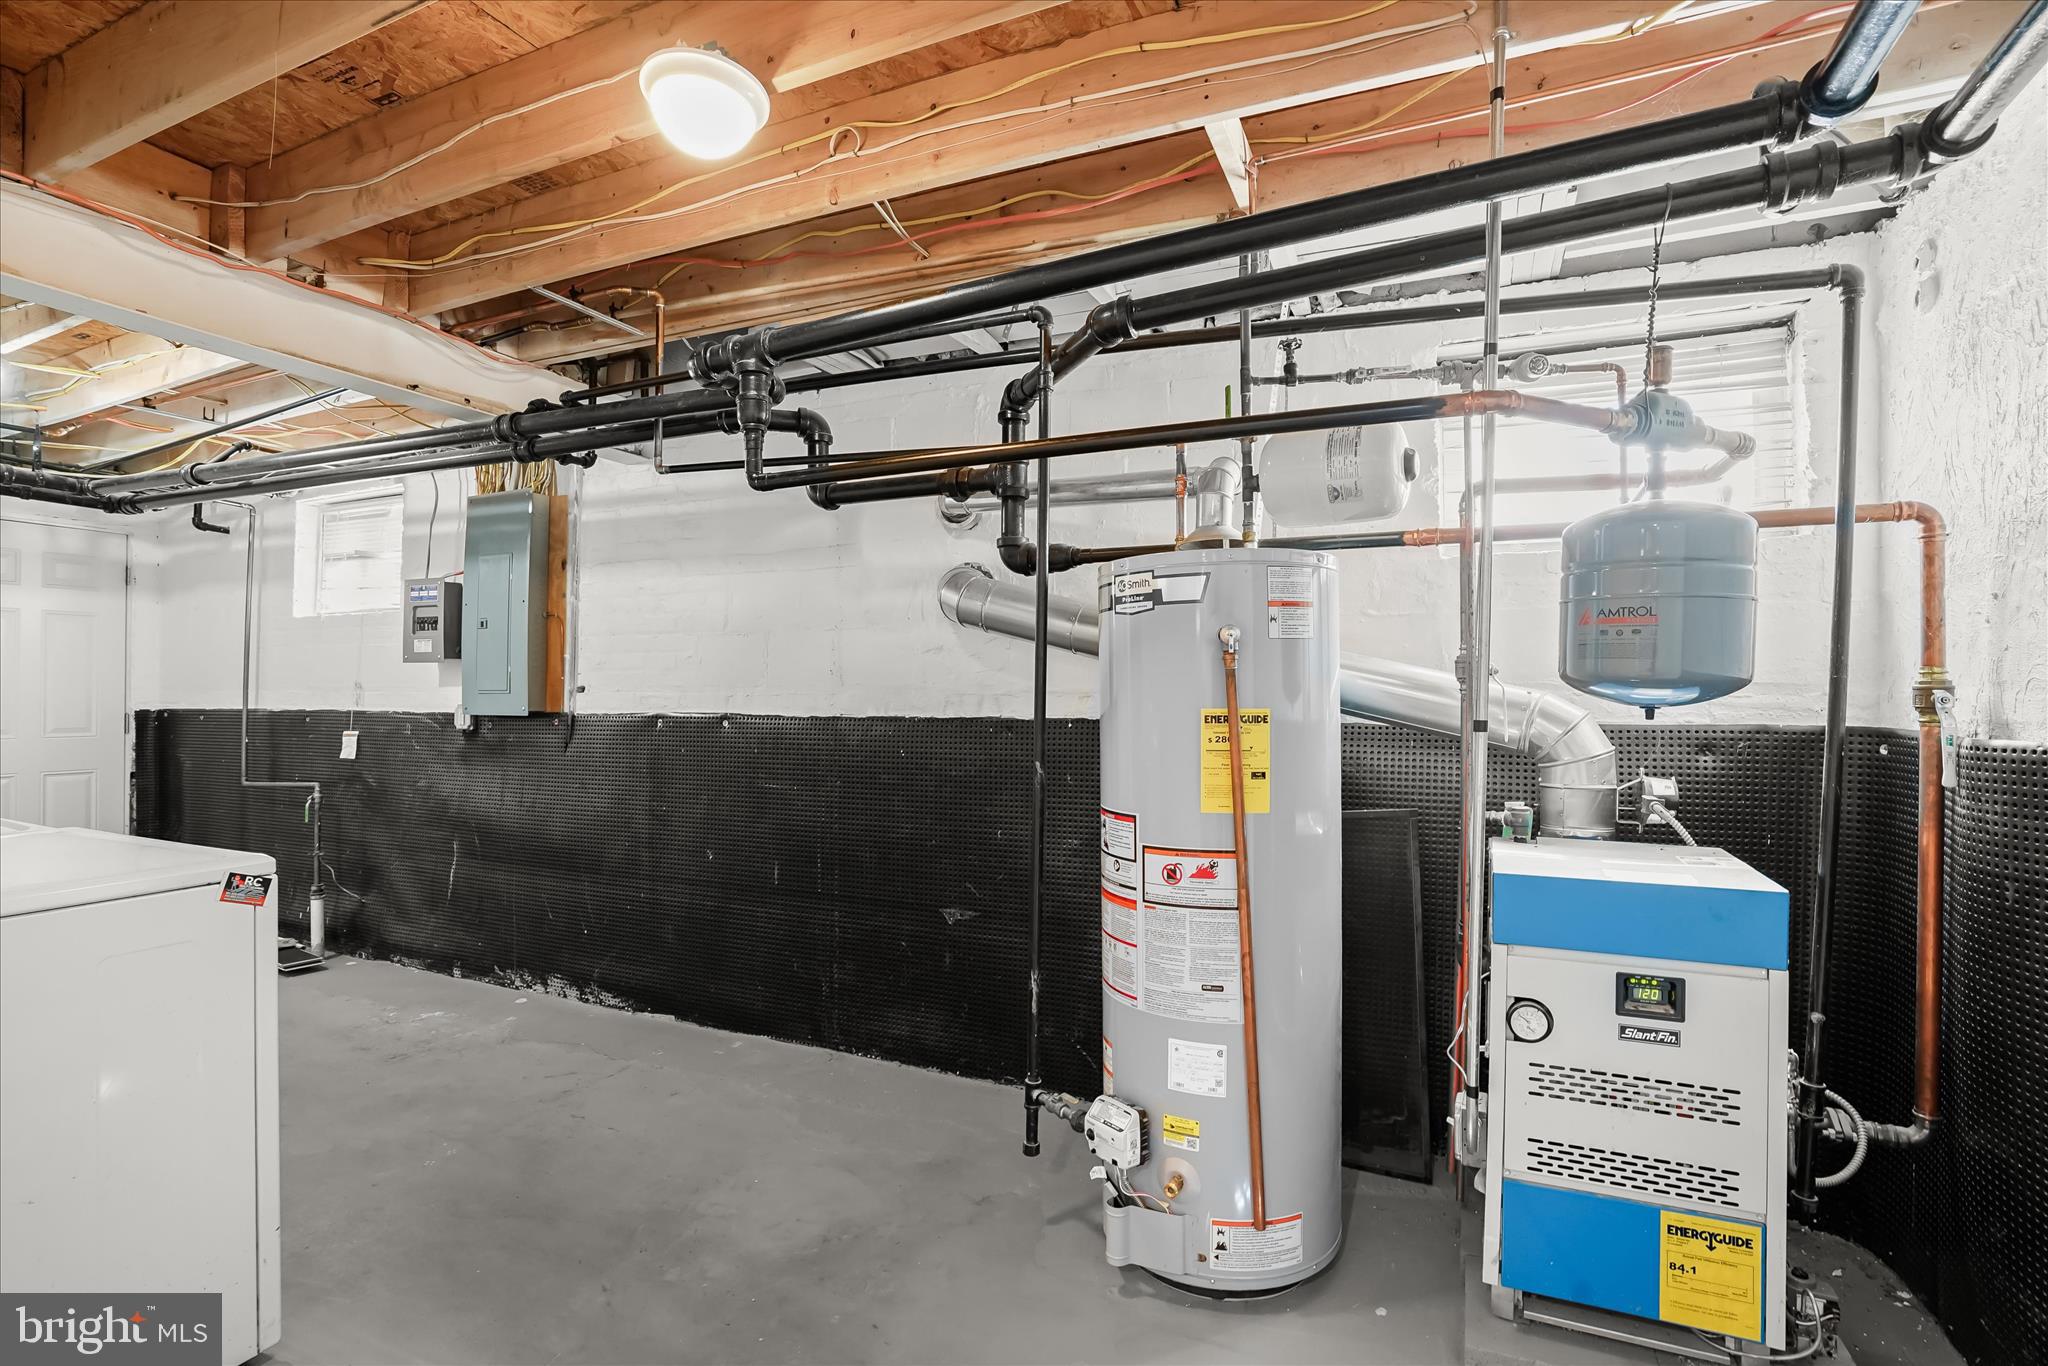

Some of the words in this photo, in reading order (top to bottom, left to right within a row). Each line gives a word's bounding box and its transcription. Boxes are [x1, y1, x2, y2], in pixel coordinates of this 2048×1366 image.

[1127, 578, 1150, 589] Smith
[1596, 606, 1657, 618] AMTROL
[1215, 735, 1230, 744] 28
[244, 876, 263, 887] RC
[1638, 988, 1659, 1000] 120
[1667, 1224, 1754, 1250] ENERGYGUIDE
[1669, 1262, 1697, 1275] 84.1
